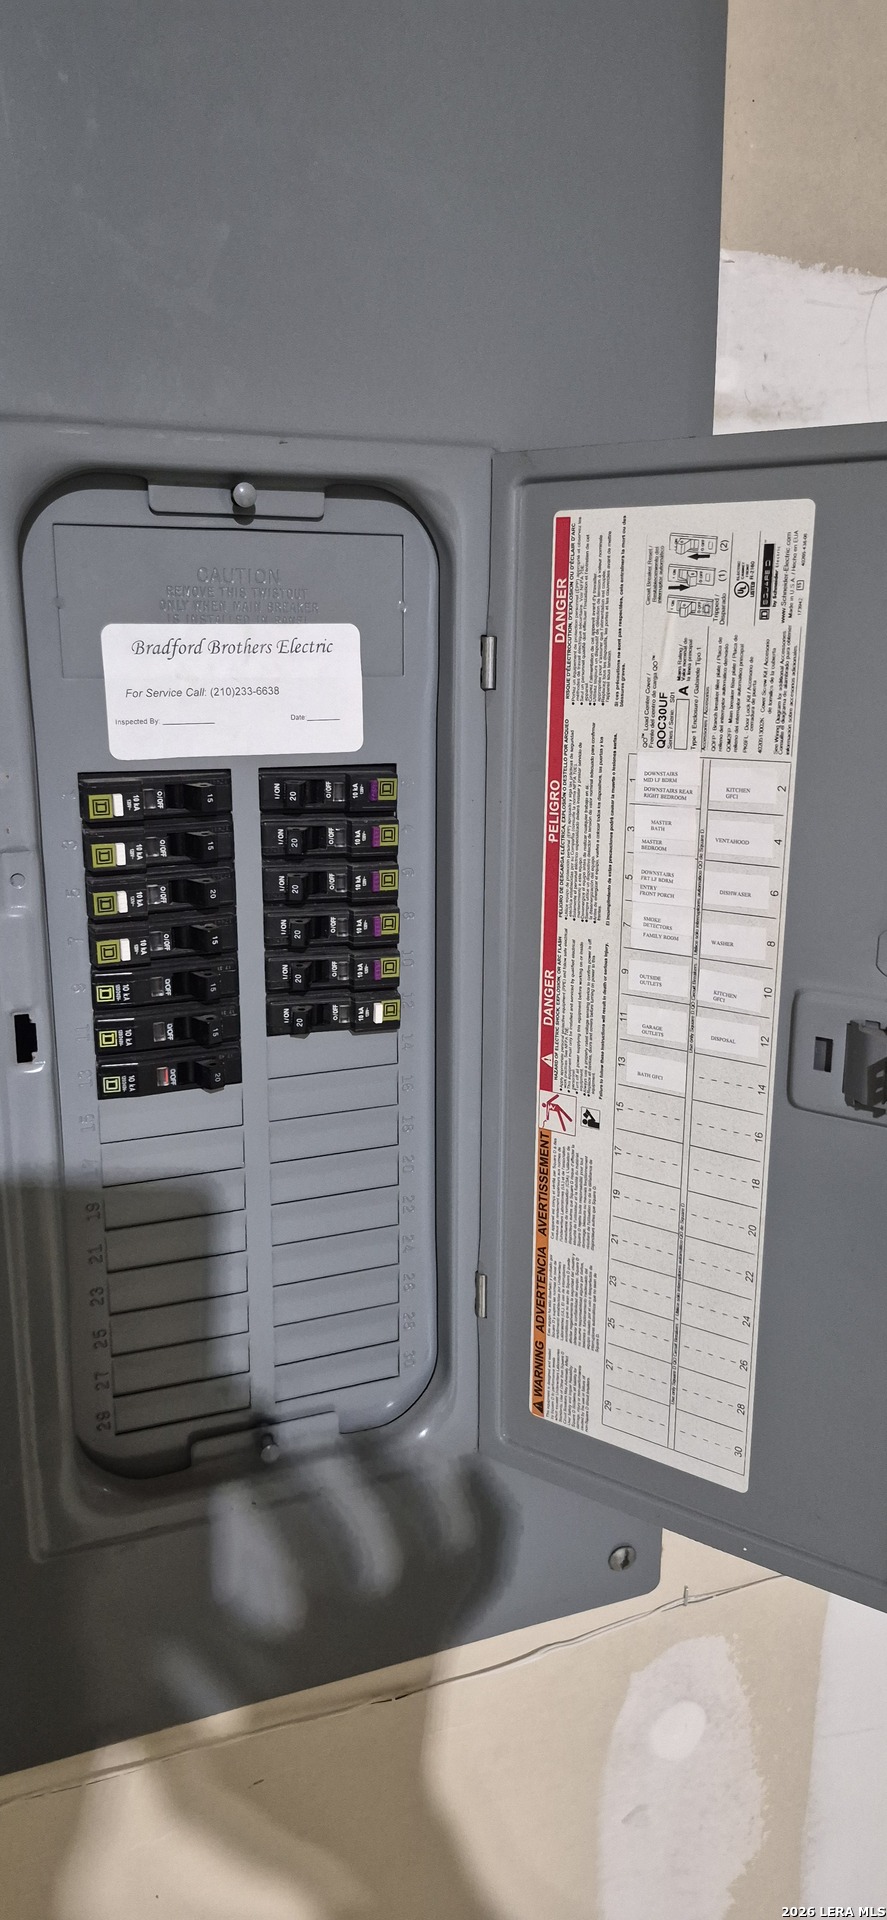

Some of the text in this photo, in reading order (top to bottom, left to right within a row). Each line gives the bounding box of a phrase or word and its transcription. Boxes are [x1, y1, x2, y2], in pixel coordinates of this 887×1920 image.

[720, 539, 729, 552] (2)
[197, 567, 280, 584] CAUTION
[718, 569, 727, 582] (1)
[166, 585, 215, 598] REMOVE
[220, 587, 247, 599] THIS
[554, 578, 567, 643] DANGER
[712, 598, 720, 622] Tripped
[719, 593, 727, 625] Disparado
[131, 637, 334, 660] Bradford Brothers Electric
[125, 686, 280, 698] For Service Call: (210)233-6638
[679, 686, 689, 696] A
[115, 718, 148, 726] Inspected
[656, 692, 668, 749] QOC30UF
[207, 793, 214, 803] 15
[289, 791, 297, 801] 20
[549, 780, 560, 842] PELIGRO
[291, 838, 298, 848] 20
[715, 837, 750, 845] VENTAHOOD
[641, 869, 675, 878] DOWNSTAIRS
[209, 889, 217, 899] 20
[292, 884, 299, 894] 20
[643, 922, 673, 930] DETECTORS
[212, 936, 219, 945] 15
[294, 930, 301, 940] 20
[295, 974, 302, 984] 20
[543, 969, 555, 1026] DANGER
[713, 990, 737, 999] KITCHEN
[764, 987, 773, 998] 10
[620, 1012, 627, 1021] 11
[296, 1018, 303, 1028] 20
[642, 1023, 663, 1031] GARAGE
[711, 1036, 736, 1044] DISPOSAL
[761, 1036, 770, 1047] 12
[618, 1056, 626, 1067] 13
[214, 1073, 221, 1083] 20
[758, 1084, 766, 1095] 14
[616, 1101, 624, 1112] 15
[754, 1132, 763, 1143] 16
[615, 1146, 622, 1156] 17
[752, 1179, 761, 1190] 18
[613, 1189, 621, 1200] 19
[748, 1224, 757, 1236] 20
[611, 1233, 619, 1244] 21
[534, 1131, 549, 1397] WARNING ADVERTENCIA AVERTISSEMENT
[609, 1276, 617, 1287] 23
[745, 1271, 754, 1283] 22
[607, 1317, 616, 1329] 25
[742, 1316, 751, 1327] 24
[605, 1359, 614, 1371] 27
[739, 1360, 748, 1371] 26
[95, 1370, 108, 1391] 27
[604, 1400, 612, 1411] 29
[737, 1404, 746, 1415] 28
[734, 1446, 743, 1457] 30
